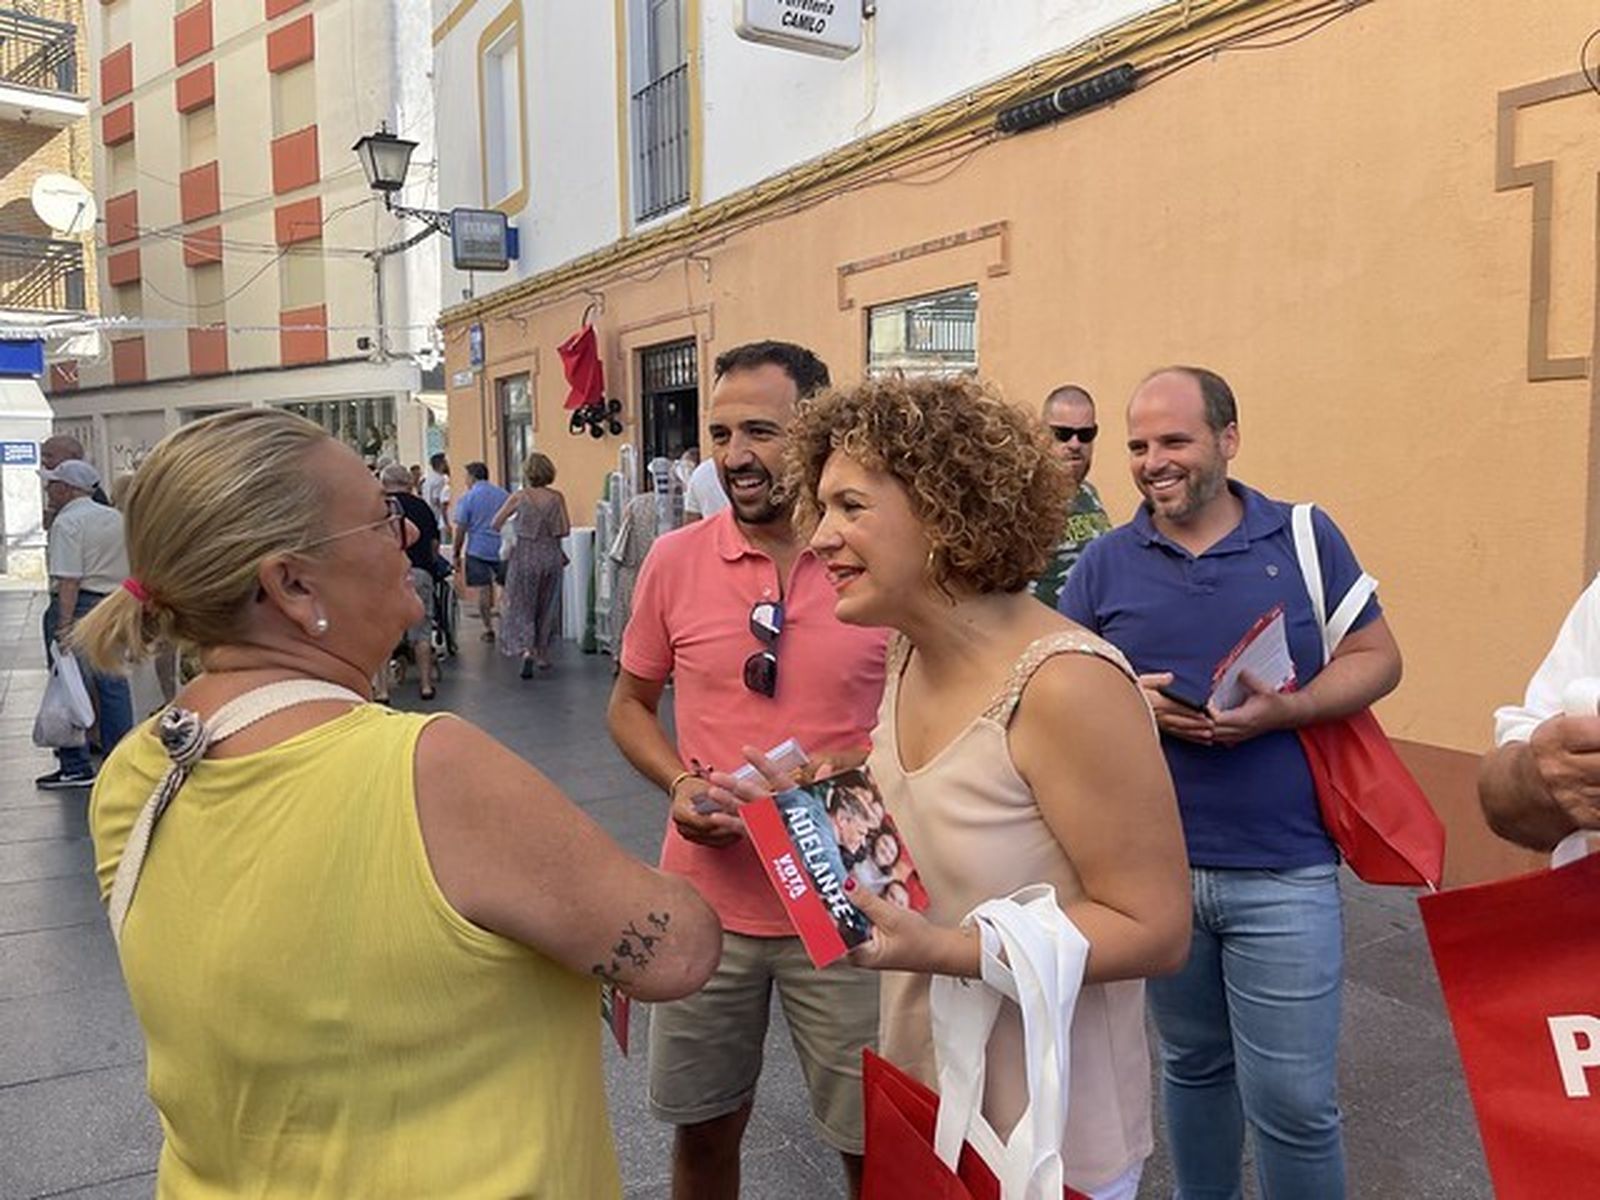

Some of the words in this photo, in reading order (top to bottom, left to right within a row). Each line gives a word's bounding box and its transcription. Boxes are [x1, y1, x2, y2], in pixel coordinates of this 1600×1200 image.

[782, 11, 826, 34] CAMILO
[778, 853, 808, 898] VOTA
[785, 806, 854, 919] ADELANTE
[1547, 1014, 1600, 1098] P
